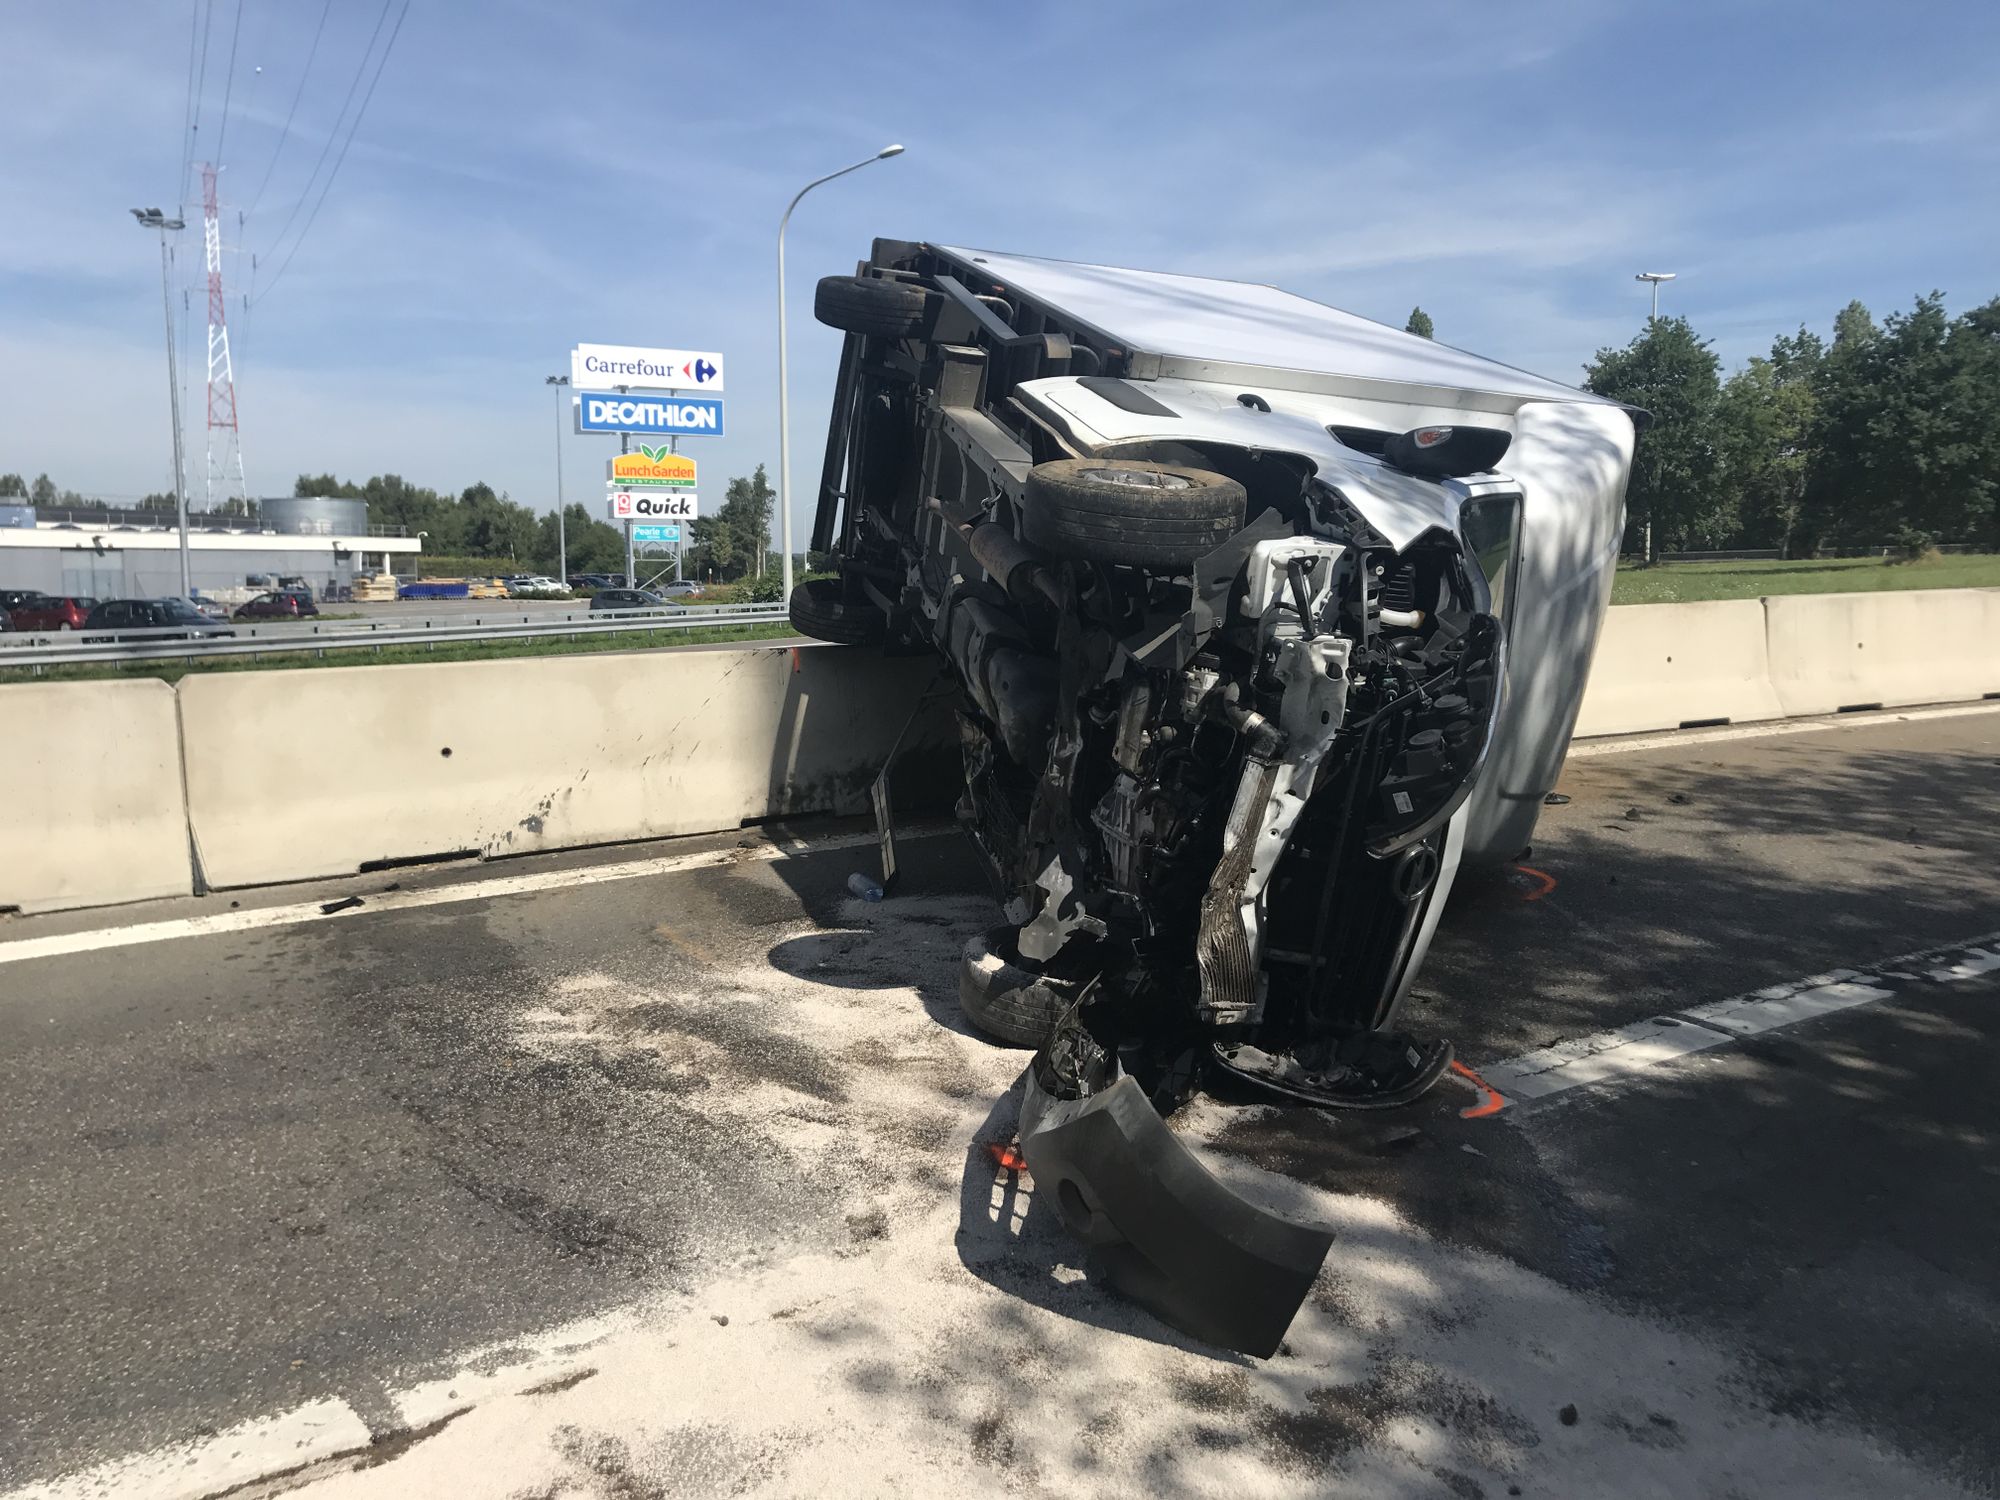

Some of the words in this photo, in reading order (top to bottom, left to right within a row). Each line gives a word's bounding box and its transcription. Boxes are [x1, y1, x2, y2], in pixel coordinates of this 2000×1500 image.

[586, 356, 674, 377] Carrefour
[588, 400, 716, 429] DECATHLON
[615, 464, 650, 476] Lunch
[652, 466, 694, 478] Garden
[636, 498, 691, 516] Quick
[633, 527, 660, 536] Pearle
